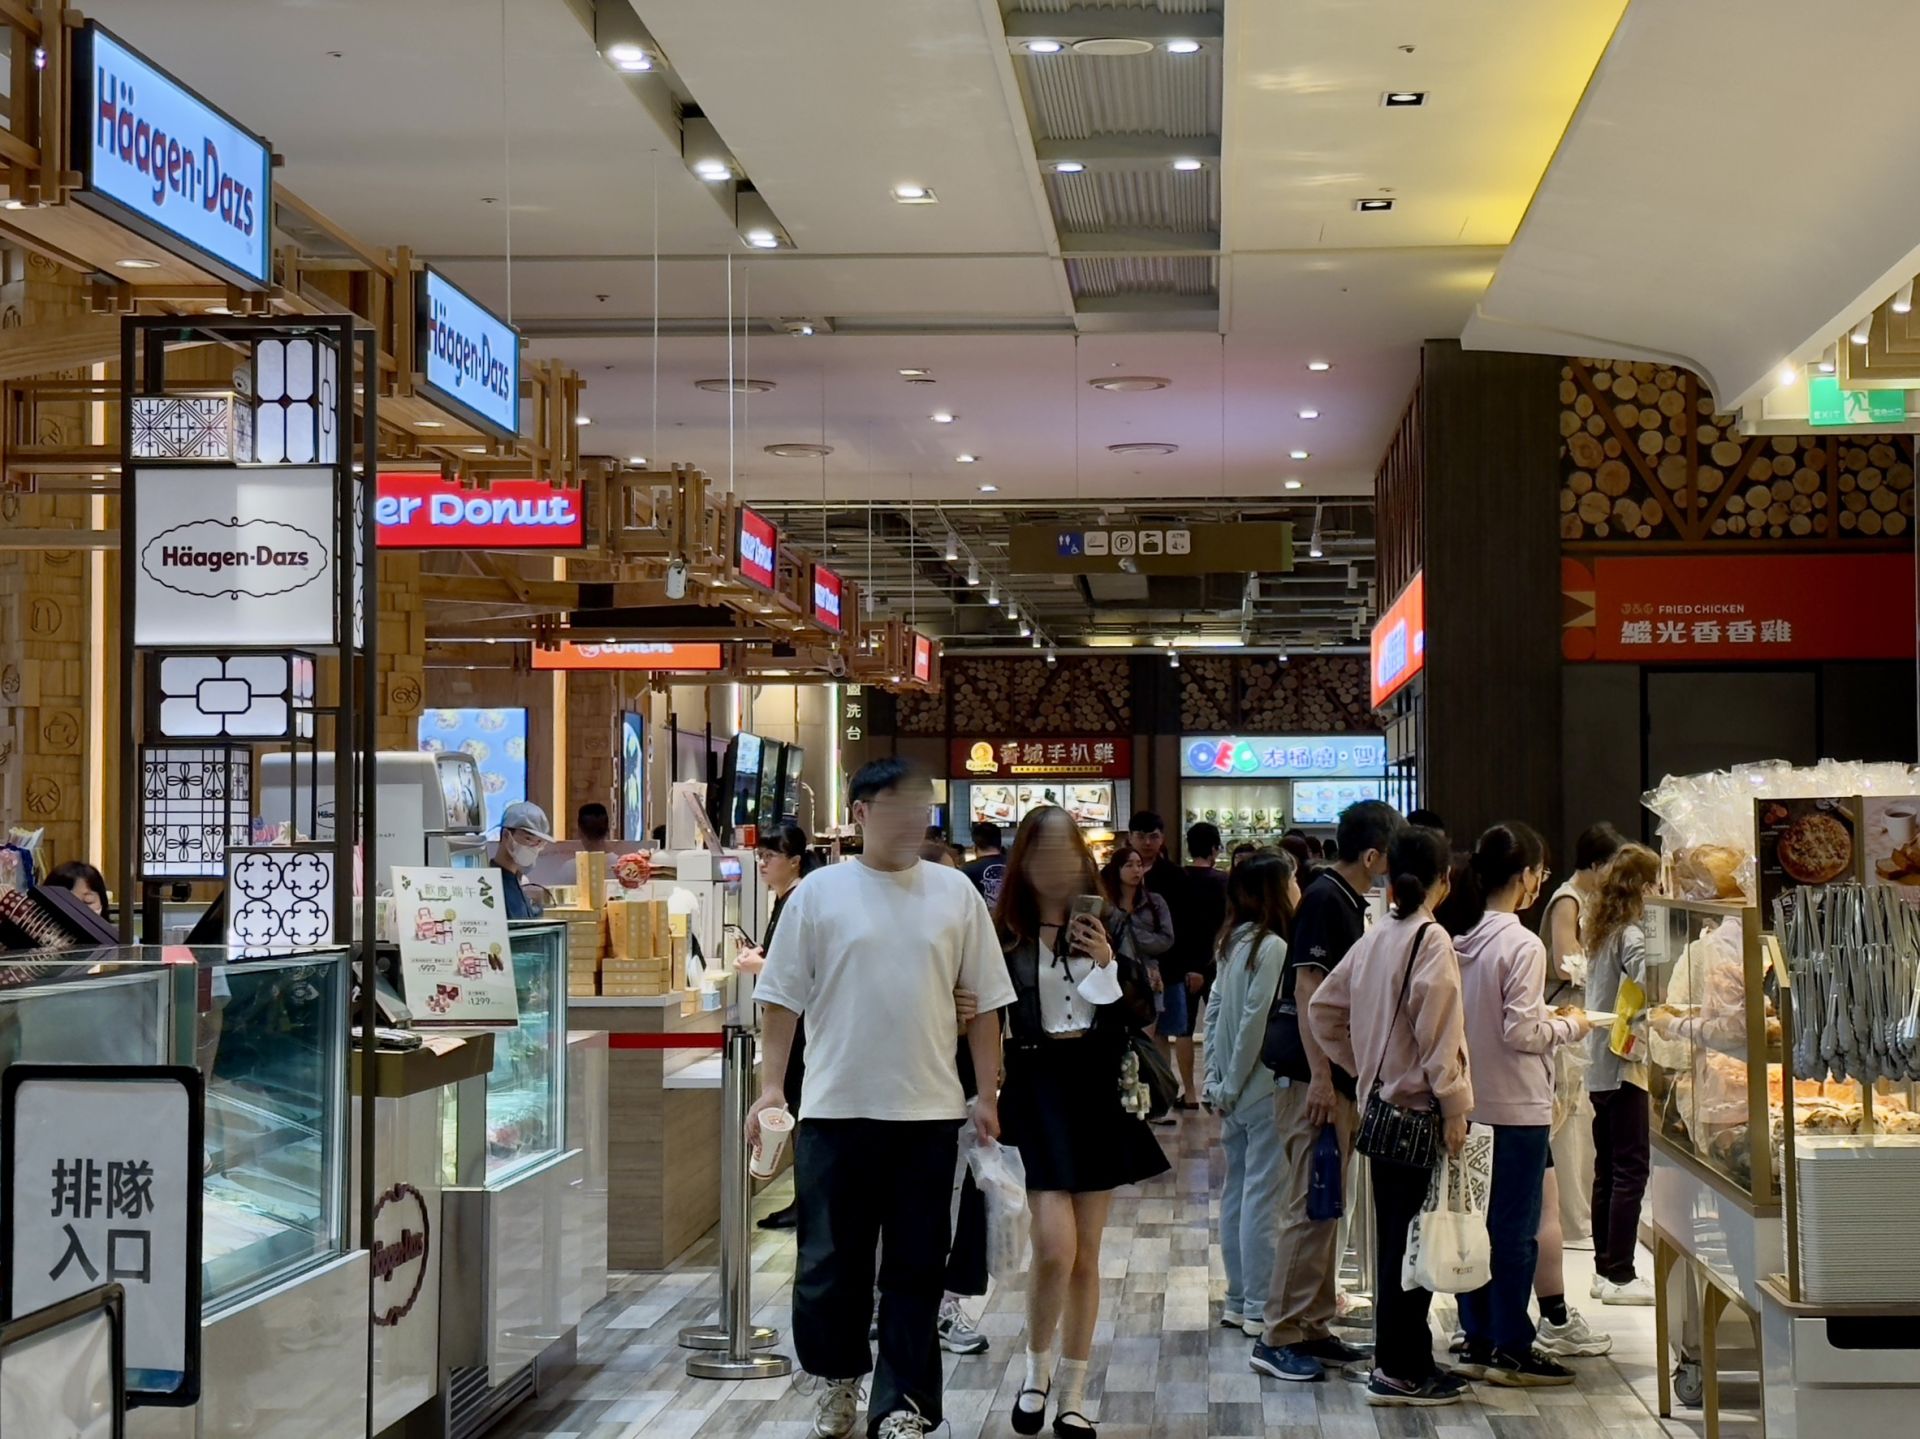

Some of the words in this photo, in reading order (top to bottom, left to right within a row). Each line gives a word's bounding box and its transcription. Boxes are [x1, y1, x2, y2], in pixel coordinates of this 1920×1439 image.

[1813, 410, 1840, 419] EXIT
[430, 493, 576, 527] Donut
[1658, 604, 1693, 614] FRIED
[1694, 603, 1745, 614] CHICKEN
[1620, 620, 1792, 644] 繼光香香雞
[50, 1158, 155, 1219] 排隊
[48, 1223, 151, 1285] 入口
